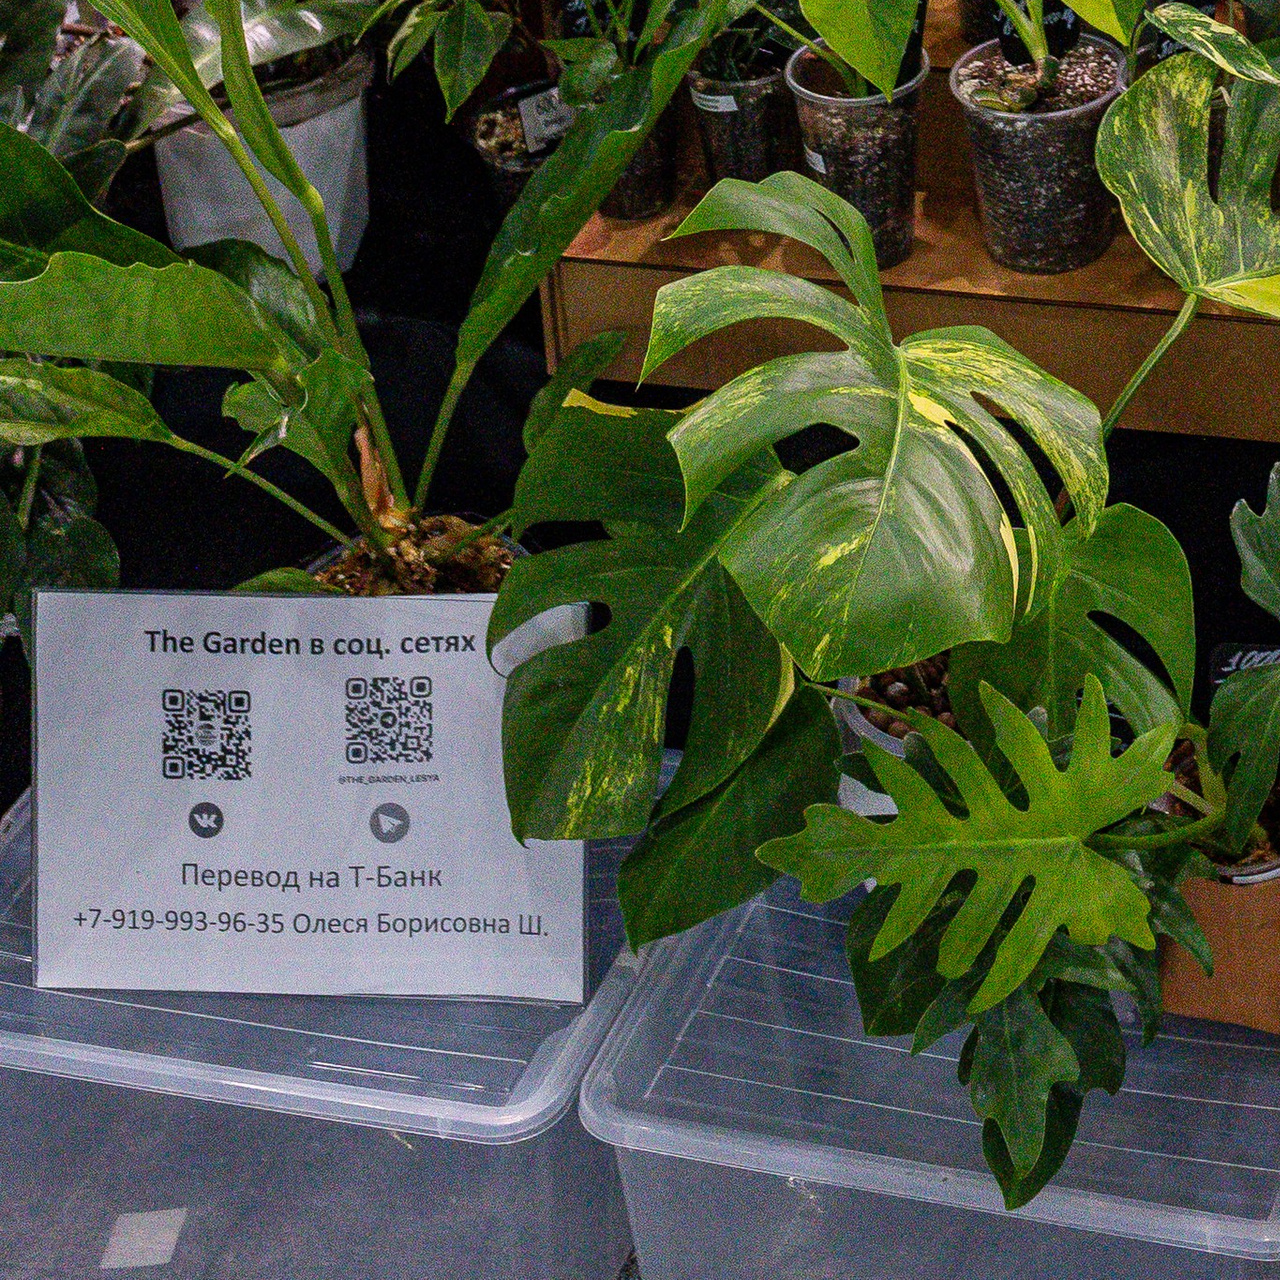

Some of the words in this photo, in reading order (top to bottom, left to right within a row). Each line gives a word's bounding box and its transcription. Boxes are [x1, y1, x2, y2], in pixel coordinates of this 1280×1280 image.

[145, 630, 194, 654] The
[203, 631, 300, 655] Garden
[311, 638, 324, 655] в
[333, 638, 390, 660] соц.
[400, 635, 476, 654] сетях
[181, 863, 301, 892] Перевод
[309, 871, 340, 889] на
[348, 865, 442, 888] Т-Банк
[73, 908, 285, 934] +7-919-993-96-35
[292, 913, 368, 934] Олеся
[377, 913, 511, 937] Борисовна
[519, 914, 549, 937] Ш.
